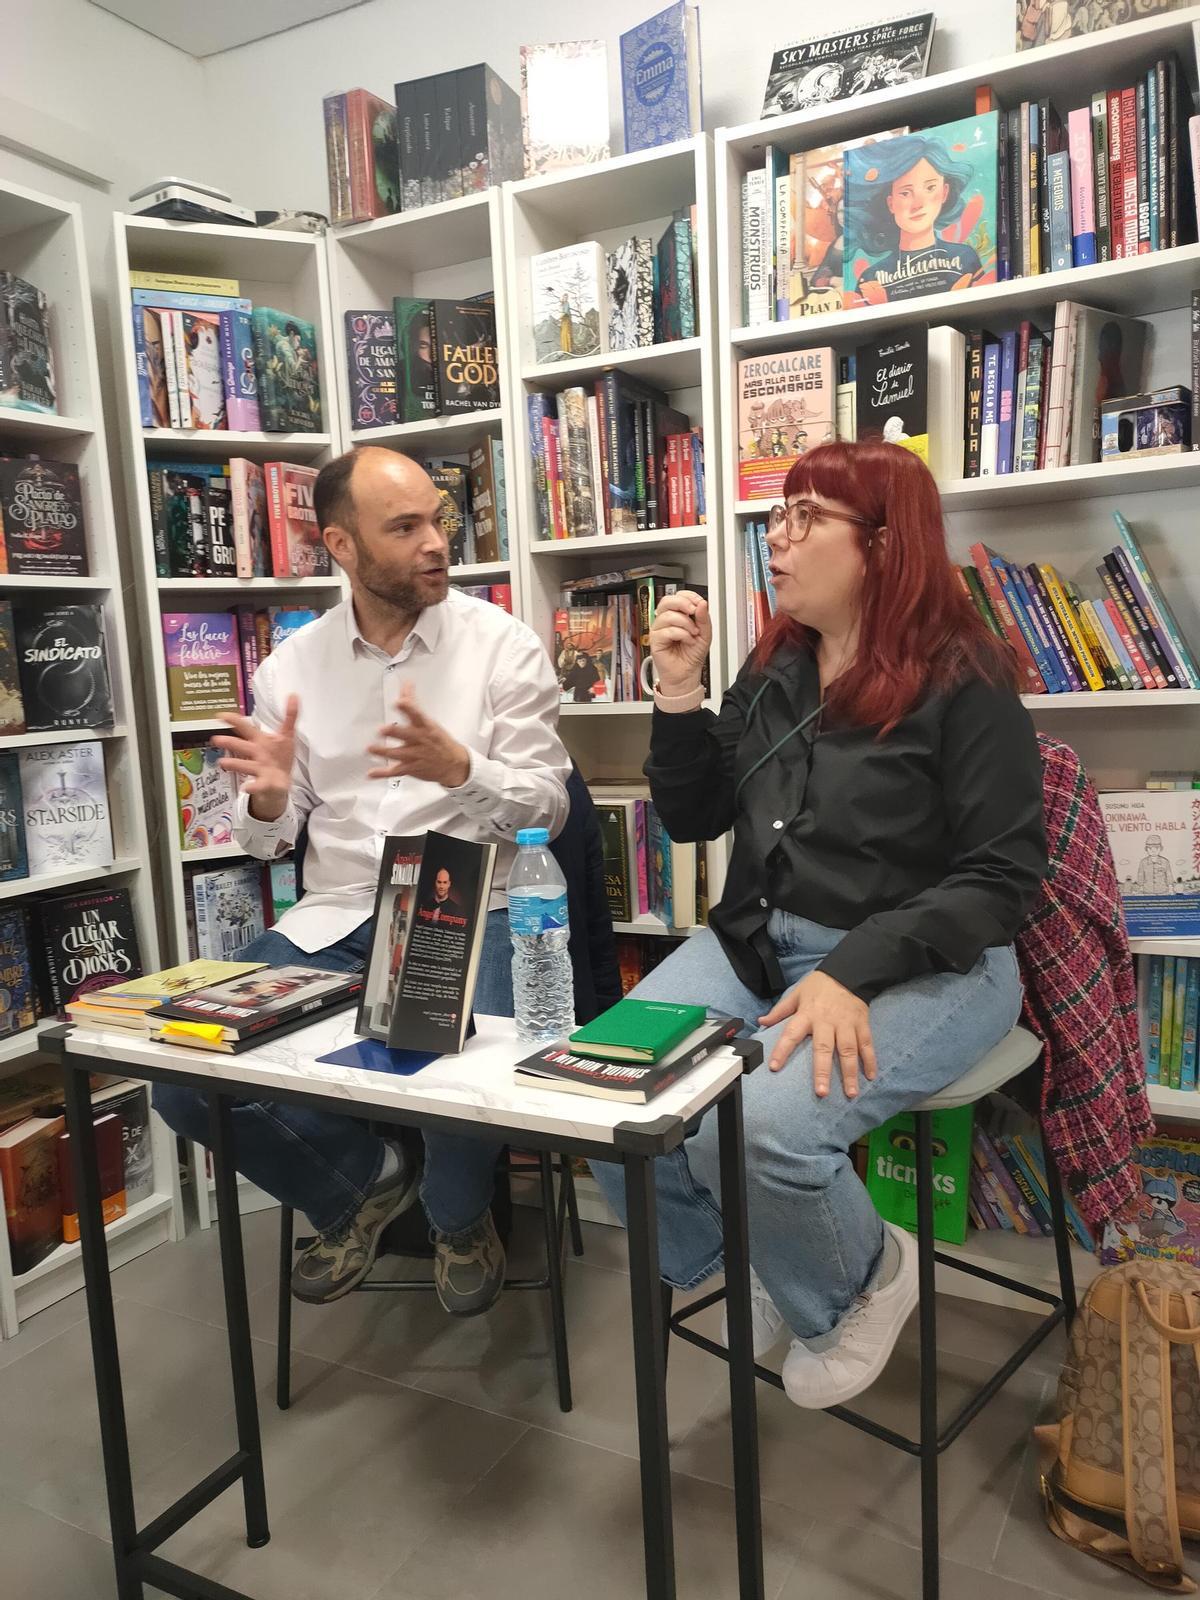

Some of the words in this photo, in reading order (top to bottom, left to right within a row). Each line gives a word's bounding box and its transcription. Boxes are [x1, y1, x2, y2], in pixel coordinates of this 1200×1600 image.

[871, 30, 896, 42] SPACE
[898, 22, 924, 36] FORCE
[780, 47, 806, 65] SKY
[808, 32, 870, 58] MASTERS
[637, 56, 674, 85] Emma
[1123, 95, 1135, 119] IGOR
[779, 184, 787, 196] LA
[1053, 169, 1064, 210] METEOROS
[1113, 163, 1122, 220] BATTLEFIELDS
[1124, 178, 1137, 216] MISTER
[1139, 202, 1149, 239] LUGOSI
[749, 207, 760, 291] MONSTRUOS
[800, 302, 829, 316] PLAN
[359, 357, 370, 367] DE
[744, 354, 821, 379] ZEROCALCARE
[988, 354, 997, 366] TE
[364, 368, 374, 378] Y
[789, 374, 801, 383] DE
[804, 371, 821, 381] LOS
[876, 368, 887, 383] El
[889, 362, 912, 379] diario
[987, 368, 996, 394] DESEO
[743, 380, 823, 399] ESCOMBROS
[891, 379, 899, 389] de
[445, 399, 472, 408] RACHEL
[473, 400, 488, 408] VAN
[986, 397, 994, 408] LO
[15, 482, 53, 501] Pacto
[54, 490, 66, 500] de
[271, 466, 280, 503] BROTHERS
[209, 506, 226, 526] PE
[273, 502, 281, 519] FIVE
[24, 511, 77, 532] PLATA
[211, 525, 223, 545] LI
[1038, 605, 1046, 614] DE
[1042, 613, 1050, 624] LOS
[178, 622, 198, 642] Las
[200, 622, 230, 642] luces
[1066, 619, 1074, 630] DEL
[54, 638, 69, 647] EL
[1121, 632, 1137, 654] AMOR
[24, 646, 102, 662] SINDICATO
[177, 641, 231, 667] febrero
[1057, 649, 1065, 658] DE
[1060, 657, 1073, 676] ALOLA
[26, 750, 56, 761] ALEX
[58, 747, 93, 759] ASTER
[196, 777, 205, 791] El
[206, 769, 220, 786] club
[26, 803, 105, 827] STARSIDE
[1105, 813, 1147, 823] OKINAWA
[1119, 823, 1152, 832] VIENTO
[1155, 821, 1187, 831] HABLA
[82, 909, 101, 925] UN
[62, 920, 128, 953] LUGAR
[94, 938, 116, 956] SIN
[62, 949, 132, 986] DIOSES
[131, 1126, 143, 1138] DE
[125, 1143, 140, 1164] X
[1012, 1168, 1038, 1206] INTRUSOS
